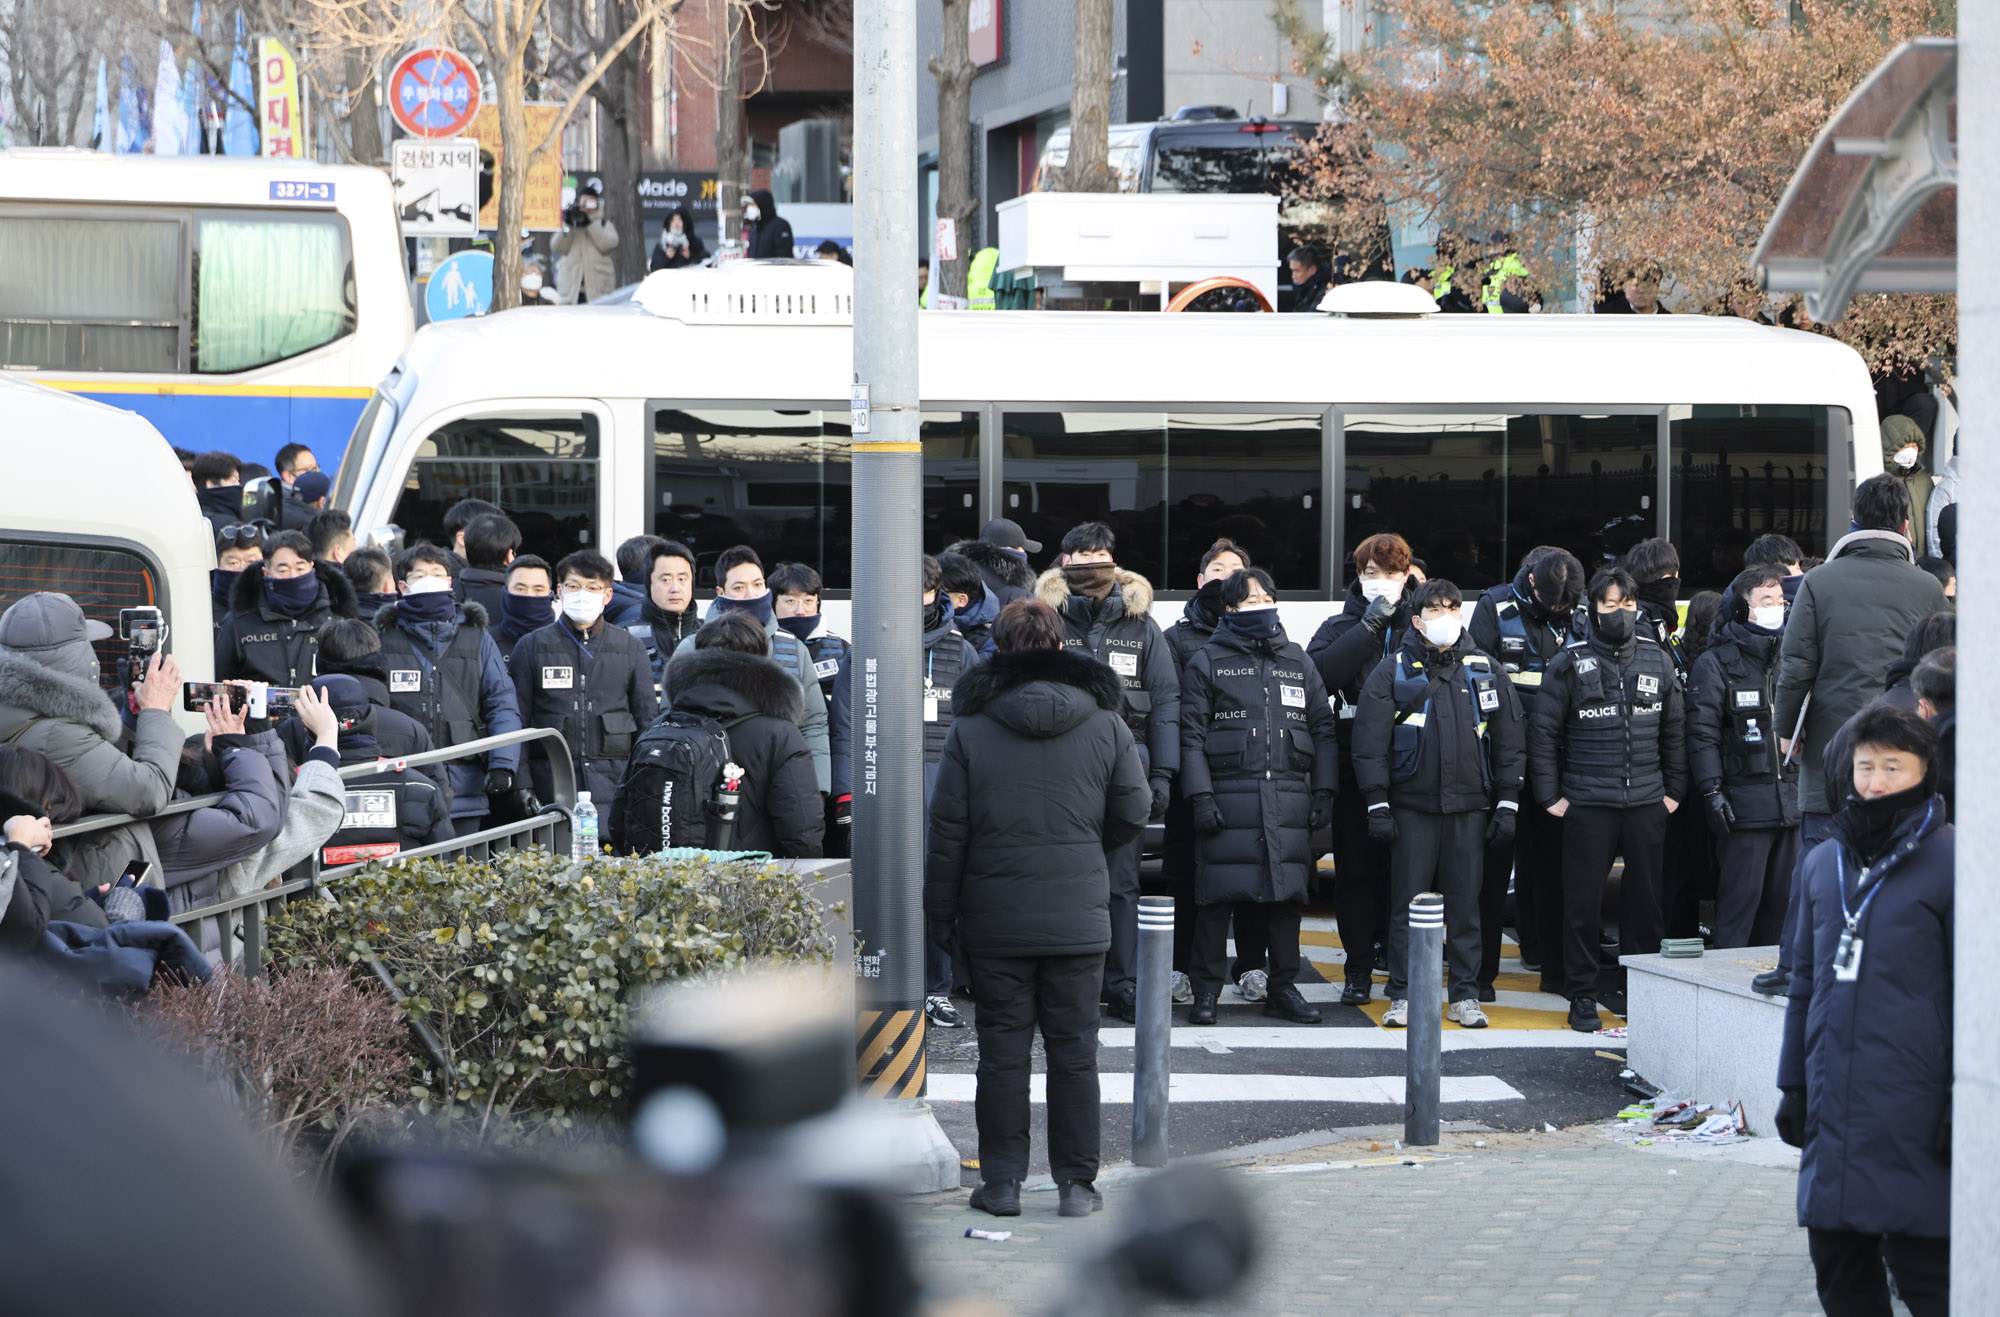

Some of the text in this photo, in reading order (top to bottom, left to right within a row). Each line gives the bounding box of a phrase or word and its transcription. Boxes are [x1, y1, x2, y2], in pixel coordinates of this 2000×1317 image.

[401, 151, 472, 168] 견인지역
[277, 182, 329, 200] 32기-3
[241, 633, 278, 644] POLICE
[1062, 639, 1083, 647] LICE
[1105, 638, 1144, 649] POLICE
[1217, 668, 1256, 677] POLICE
[1272, 670, 1305, 680] POLICE
[924, 689, 952, 699] POLIC
[1214, 710, 1247, 720] POLICE
[1579, 706, 1617, 719] POLICE
[344, 813, 385, 824] OLICE
[863, 967, 881, 978] 용산
